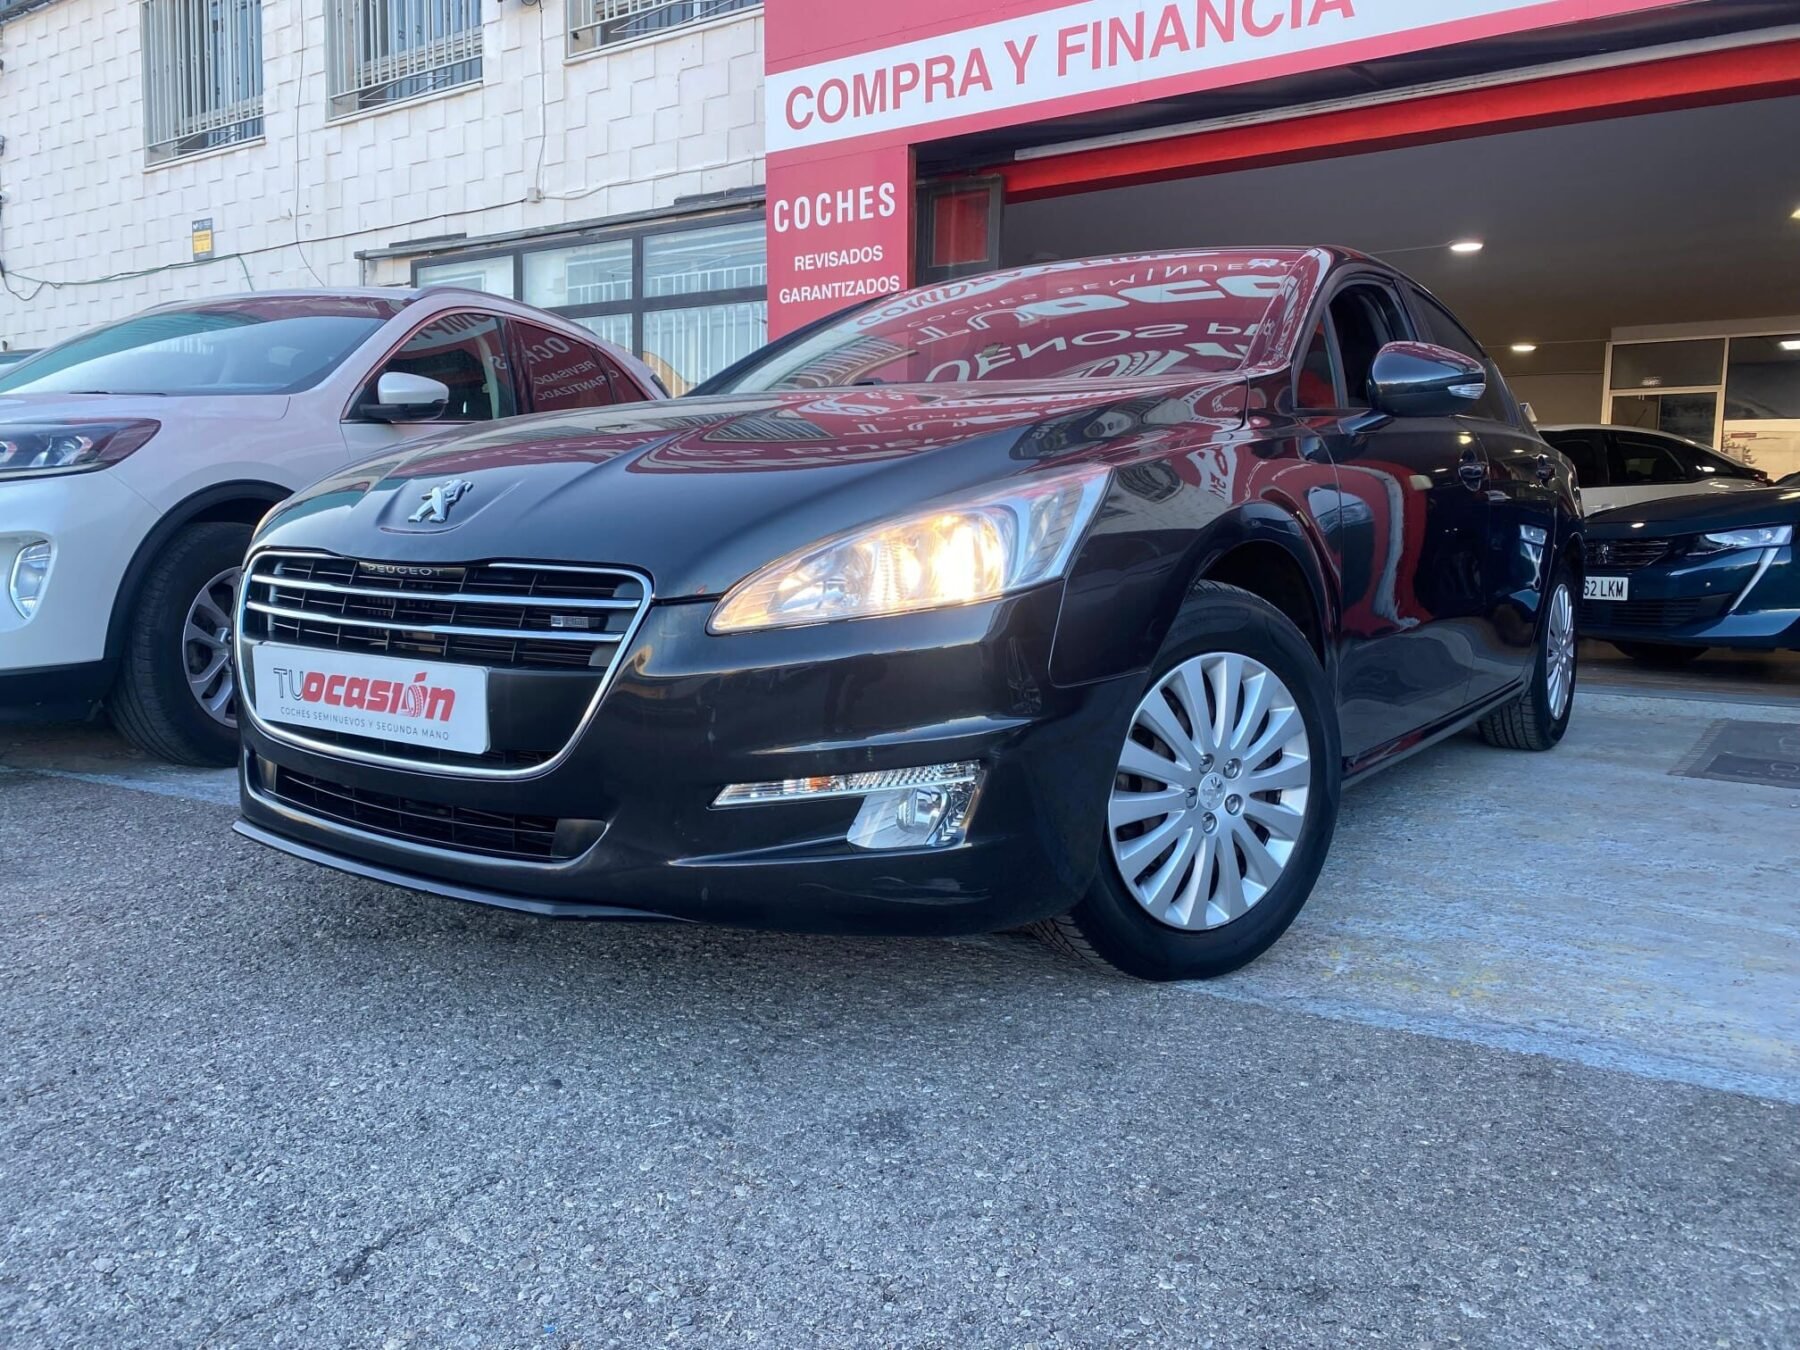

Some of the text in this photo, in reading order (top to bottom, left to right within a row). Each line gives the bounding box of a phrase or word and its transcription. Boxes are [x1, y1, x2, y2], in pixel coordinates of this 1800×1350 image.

[785, 47, 993, 130] COMPRA
[1004, 34, 1038, 85] Y
[773, 182, 896, 233] COCHES
[793, 245, 884, 272] REVISADOS
[779, 275, 900, 304] GARANTIZADOS
[367, 564, 444, 577] PEUGEOT
[1601, 580, 1624, 598] LKM
[280, 706, 449, 741] COCHES SEMINUEVOS Y SEGUNDA MANO
